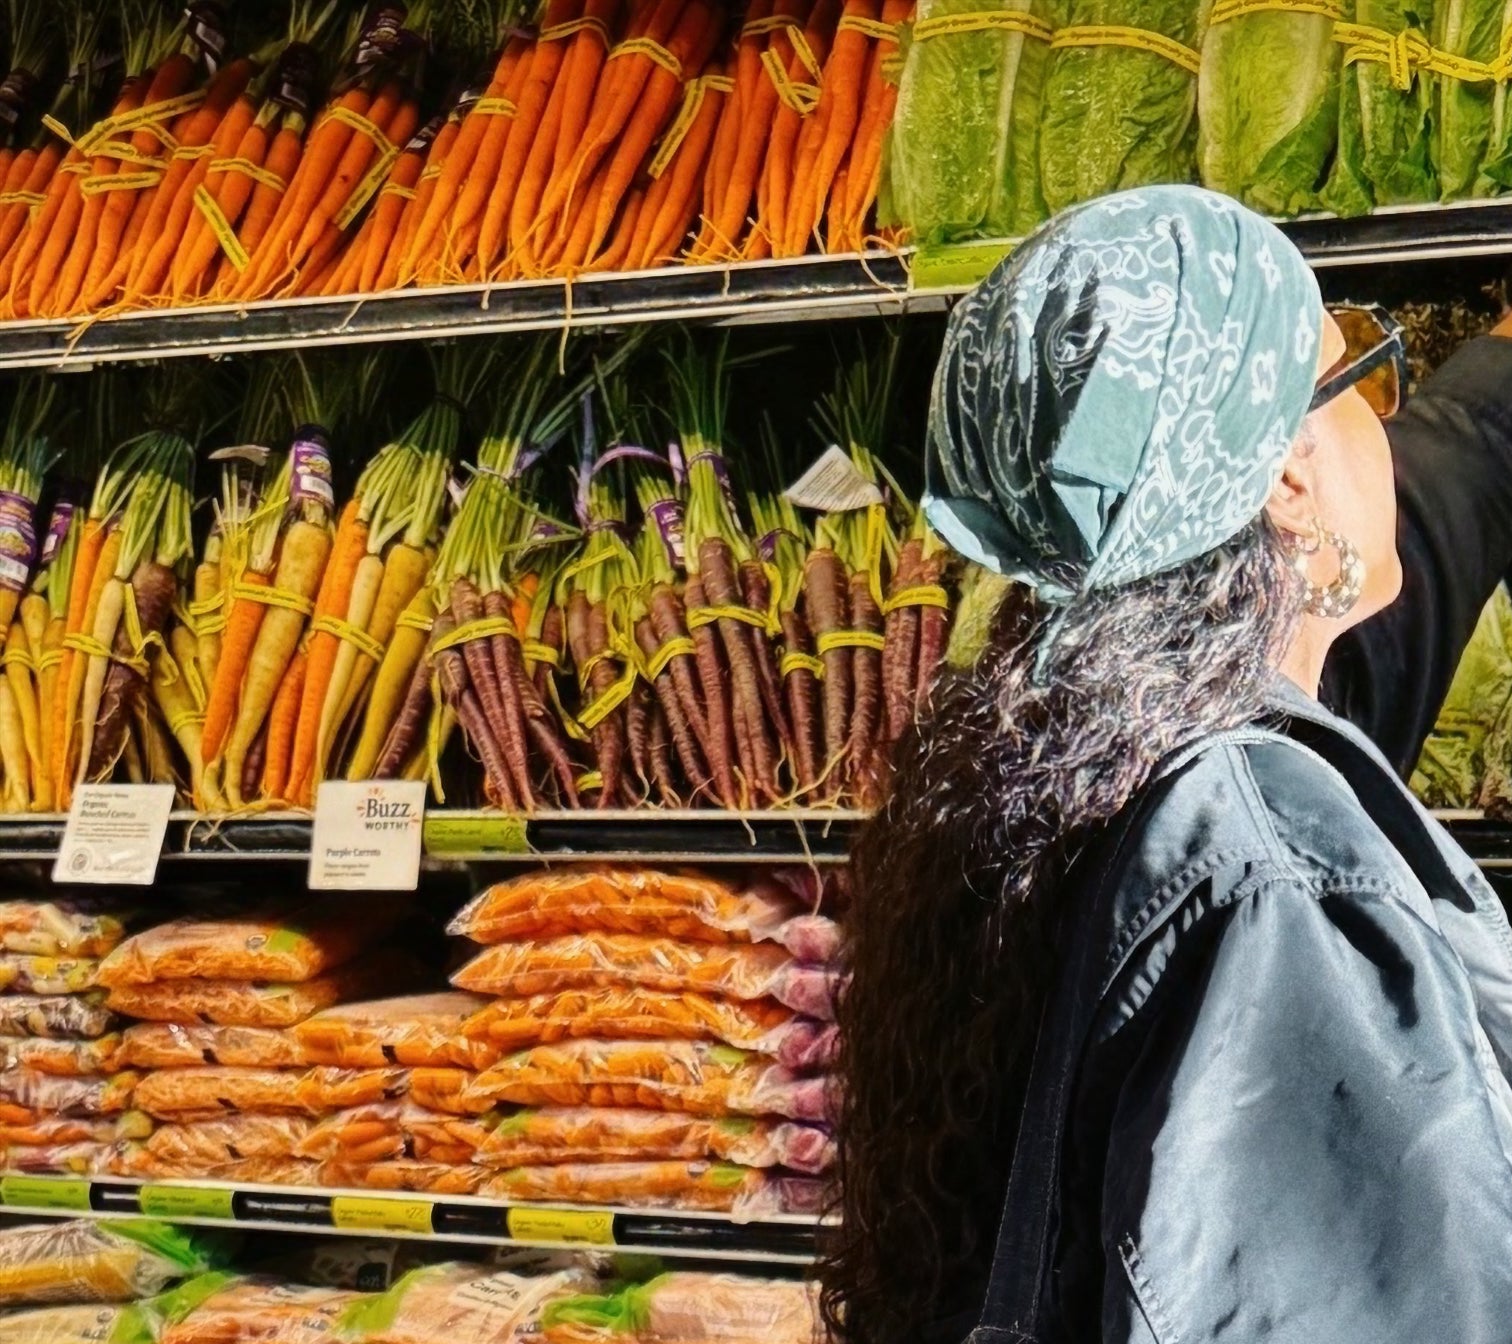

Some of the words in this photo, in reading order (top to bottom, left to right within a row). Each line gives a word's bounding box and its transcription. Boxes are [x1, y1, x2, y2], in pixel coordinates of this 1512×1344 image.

[366, 797, 412, 818] Buzz
[364, 821, 410, 832] WORTHY
[325, 847, 353, 860] Purple
